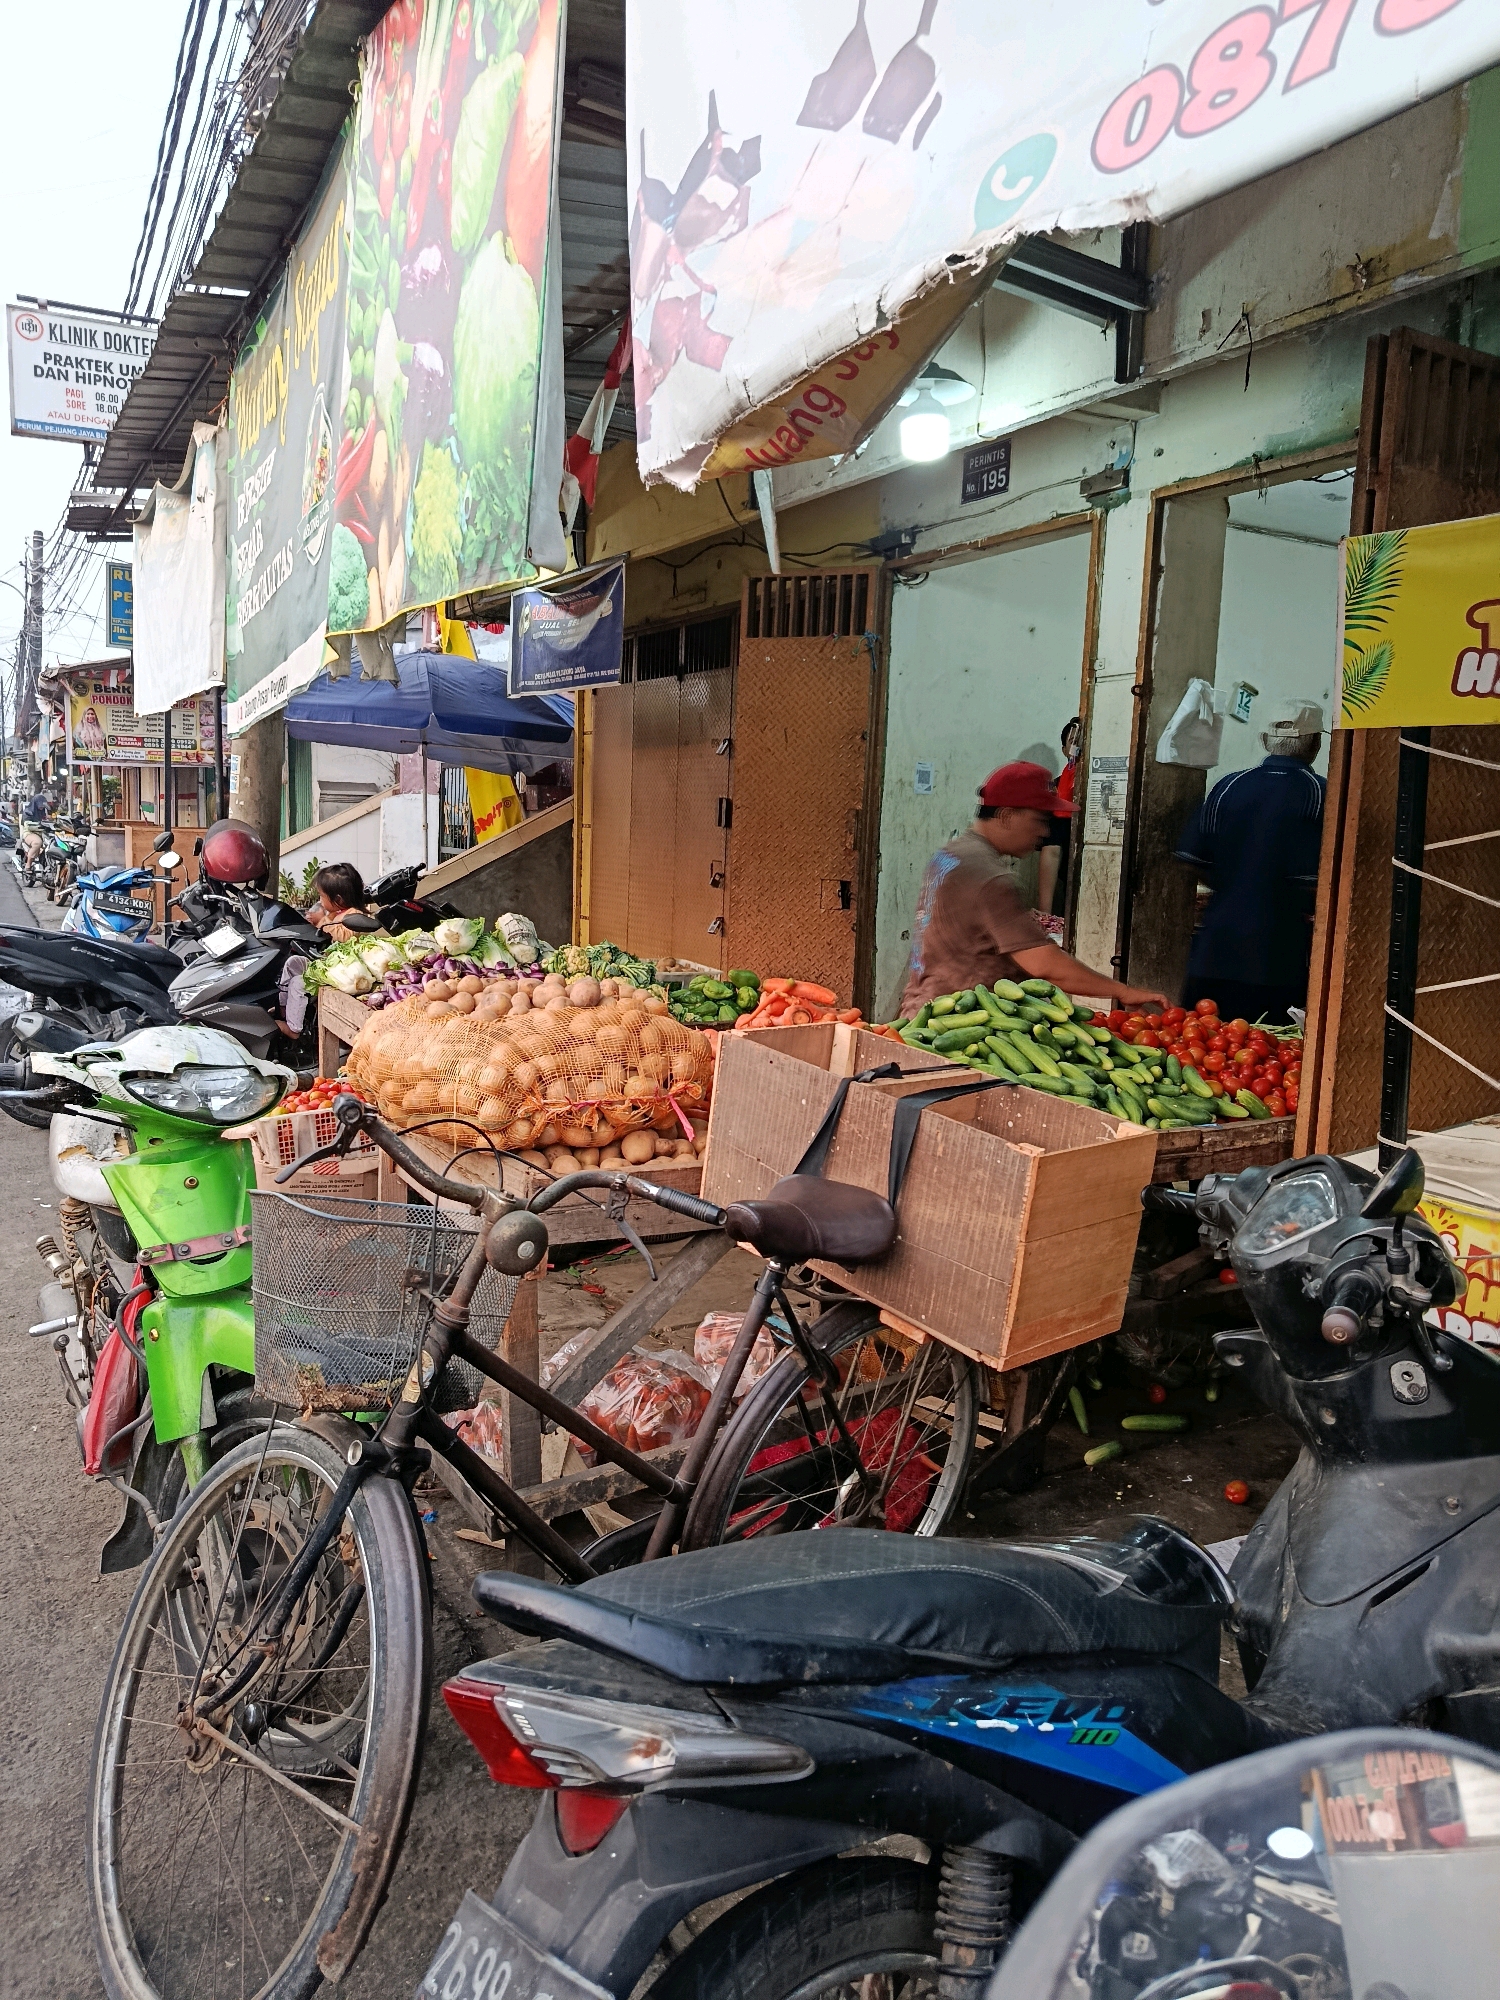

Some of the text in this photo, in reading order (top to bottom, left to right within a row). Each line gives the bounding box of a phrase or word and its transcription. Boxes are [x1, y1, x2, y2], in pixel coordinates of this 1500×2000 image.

[49, 322, 98, 348] KLINIK
[44, 352, 114, 374] PRAKTEK
[34, 365, 69, 382] DAN
[66, 388, 118, 404] PAGI 06.00
[48, 411, 70, 420] ATAU
[66, 400, 118, 414] SORE 18.00
[45, 425, 77, 436] PEJUANG
[78, 428, 95, 438] JAYA
[969, 447, 1006, 470] PERINTIS
[966, 466, 1006, 494] No. 195
[237, 447, 277, 531] BERSIH
[182, 700, 196, 710] 28
[1240, 691, 1251, 709] 12
[109, 896, 130, 905] 4134
[201, 1006, 230, 1016] HONDA
[922, 1689, 1133, 1723] REVO
[1067, 1728, 1120, 1746] 110
